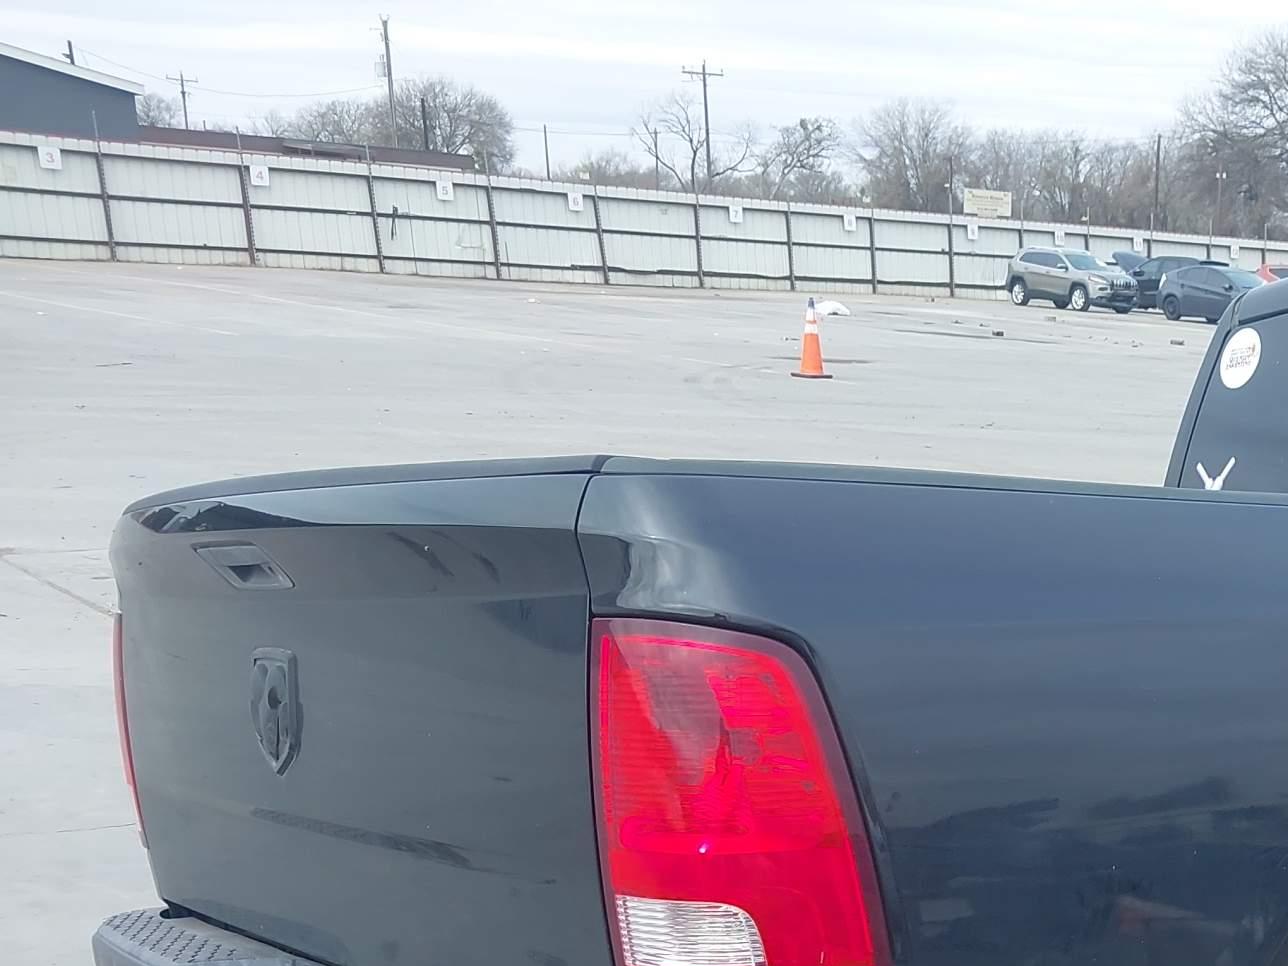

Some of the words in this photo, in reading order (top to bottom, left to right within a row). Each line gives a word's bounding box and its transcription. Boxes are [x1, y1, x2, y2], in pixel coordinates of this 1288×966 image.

[45, 152, 55, 163] 3
[255, 170, 264, 181] 4
[441, 186, 448, 196] 5
[572, 196, 579, 207] 6
